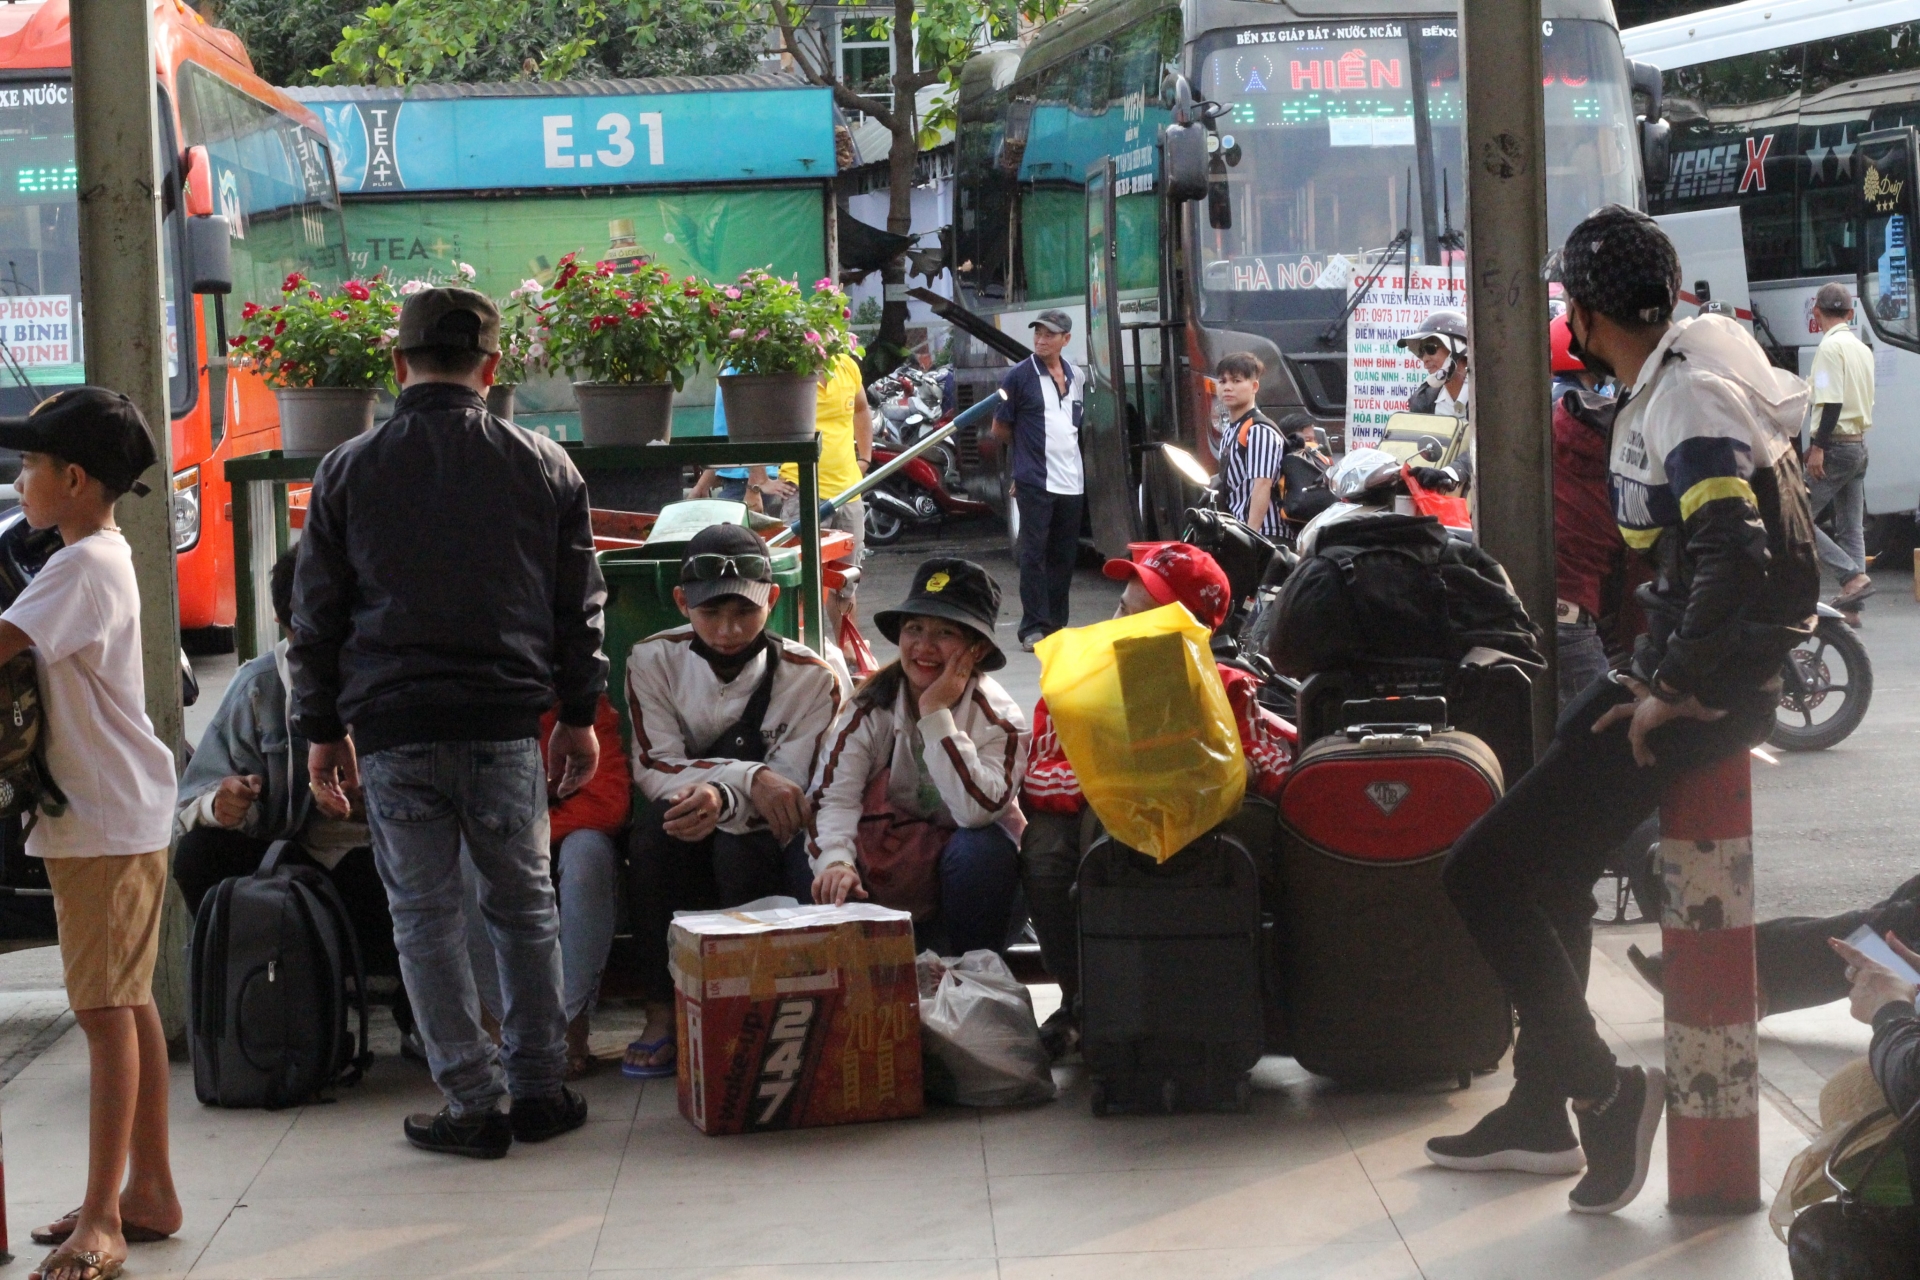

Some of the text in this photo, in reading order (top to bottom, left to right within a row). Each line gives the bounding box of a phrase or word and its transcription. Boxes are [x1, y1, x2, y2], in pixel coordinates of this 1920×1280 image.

[1236, 30, 1259, 45] BẾN
[1261, 31, 1277, 43] XE
[1278, 27, 1305, 42] GIÁP
[1307, 26, 1330, 40] BÁT
[1289, 48, 1402, 91] HIỀN
[23, 83, 68, 106] NƯỚC
[541, 112, 665, 169] E.31
[1737, 133, 1775, 194] X
[1234, 258, 1273, 291] HÀ
[1354, 275, 1388, 290] CTY
[1391, 270, 1432, 290] HỀN
[1380, 291, 1403, 305] VIÊN
[1433, 293, 1459, 307] HÀNG
[1371, 308, 1393, 323] 0975
[1396, 309, 1412, 323] 177
[13, 319, 68, 341] BÌNH
[10, 344, 69, 367] ĐỊNH
[1379, 342, 1391, 354] HÀ
[1353, 357, 1374, 368] NINH
[1376, 356, 1396, 369] BÌNH
[1381, 371, 1399, 382] NINH
[1354, 384, 1369, 396] THÁI
[1370, 384, 1385, 396] BÌNH
[1353, 397, 1381, 410] TUYÊN
[756, 998, 816, 1126] 247
